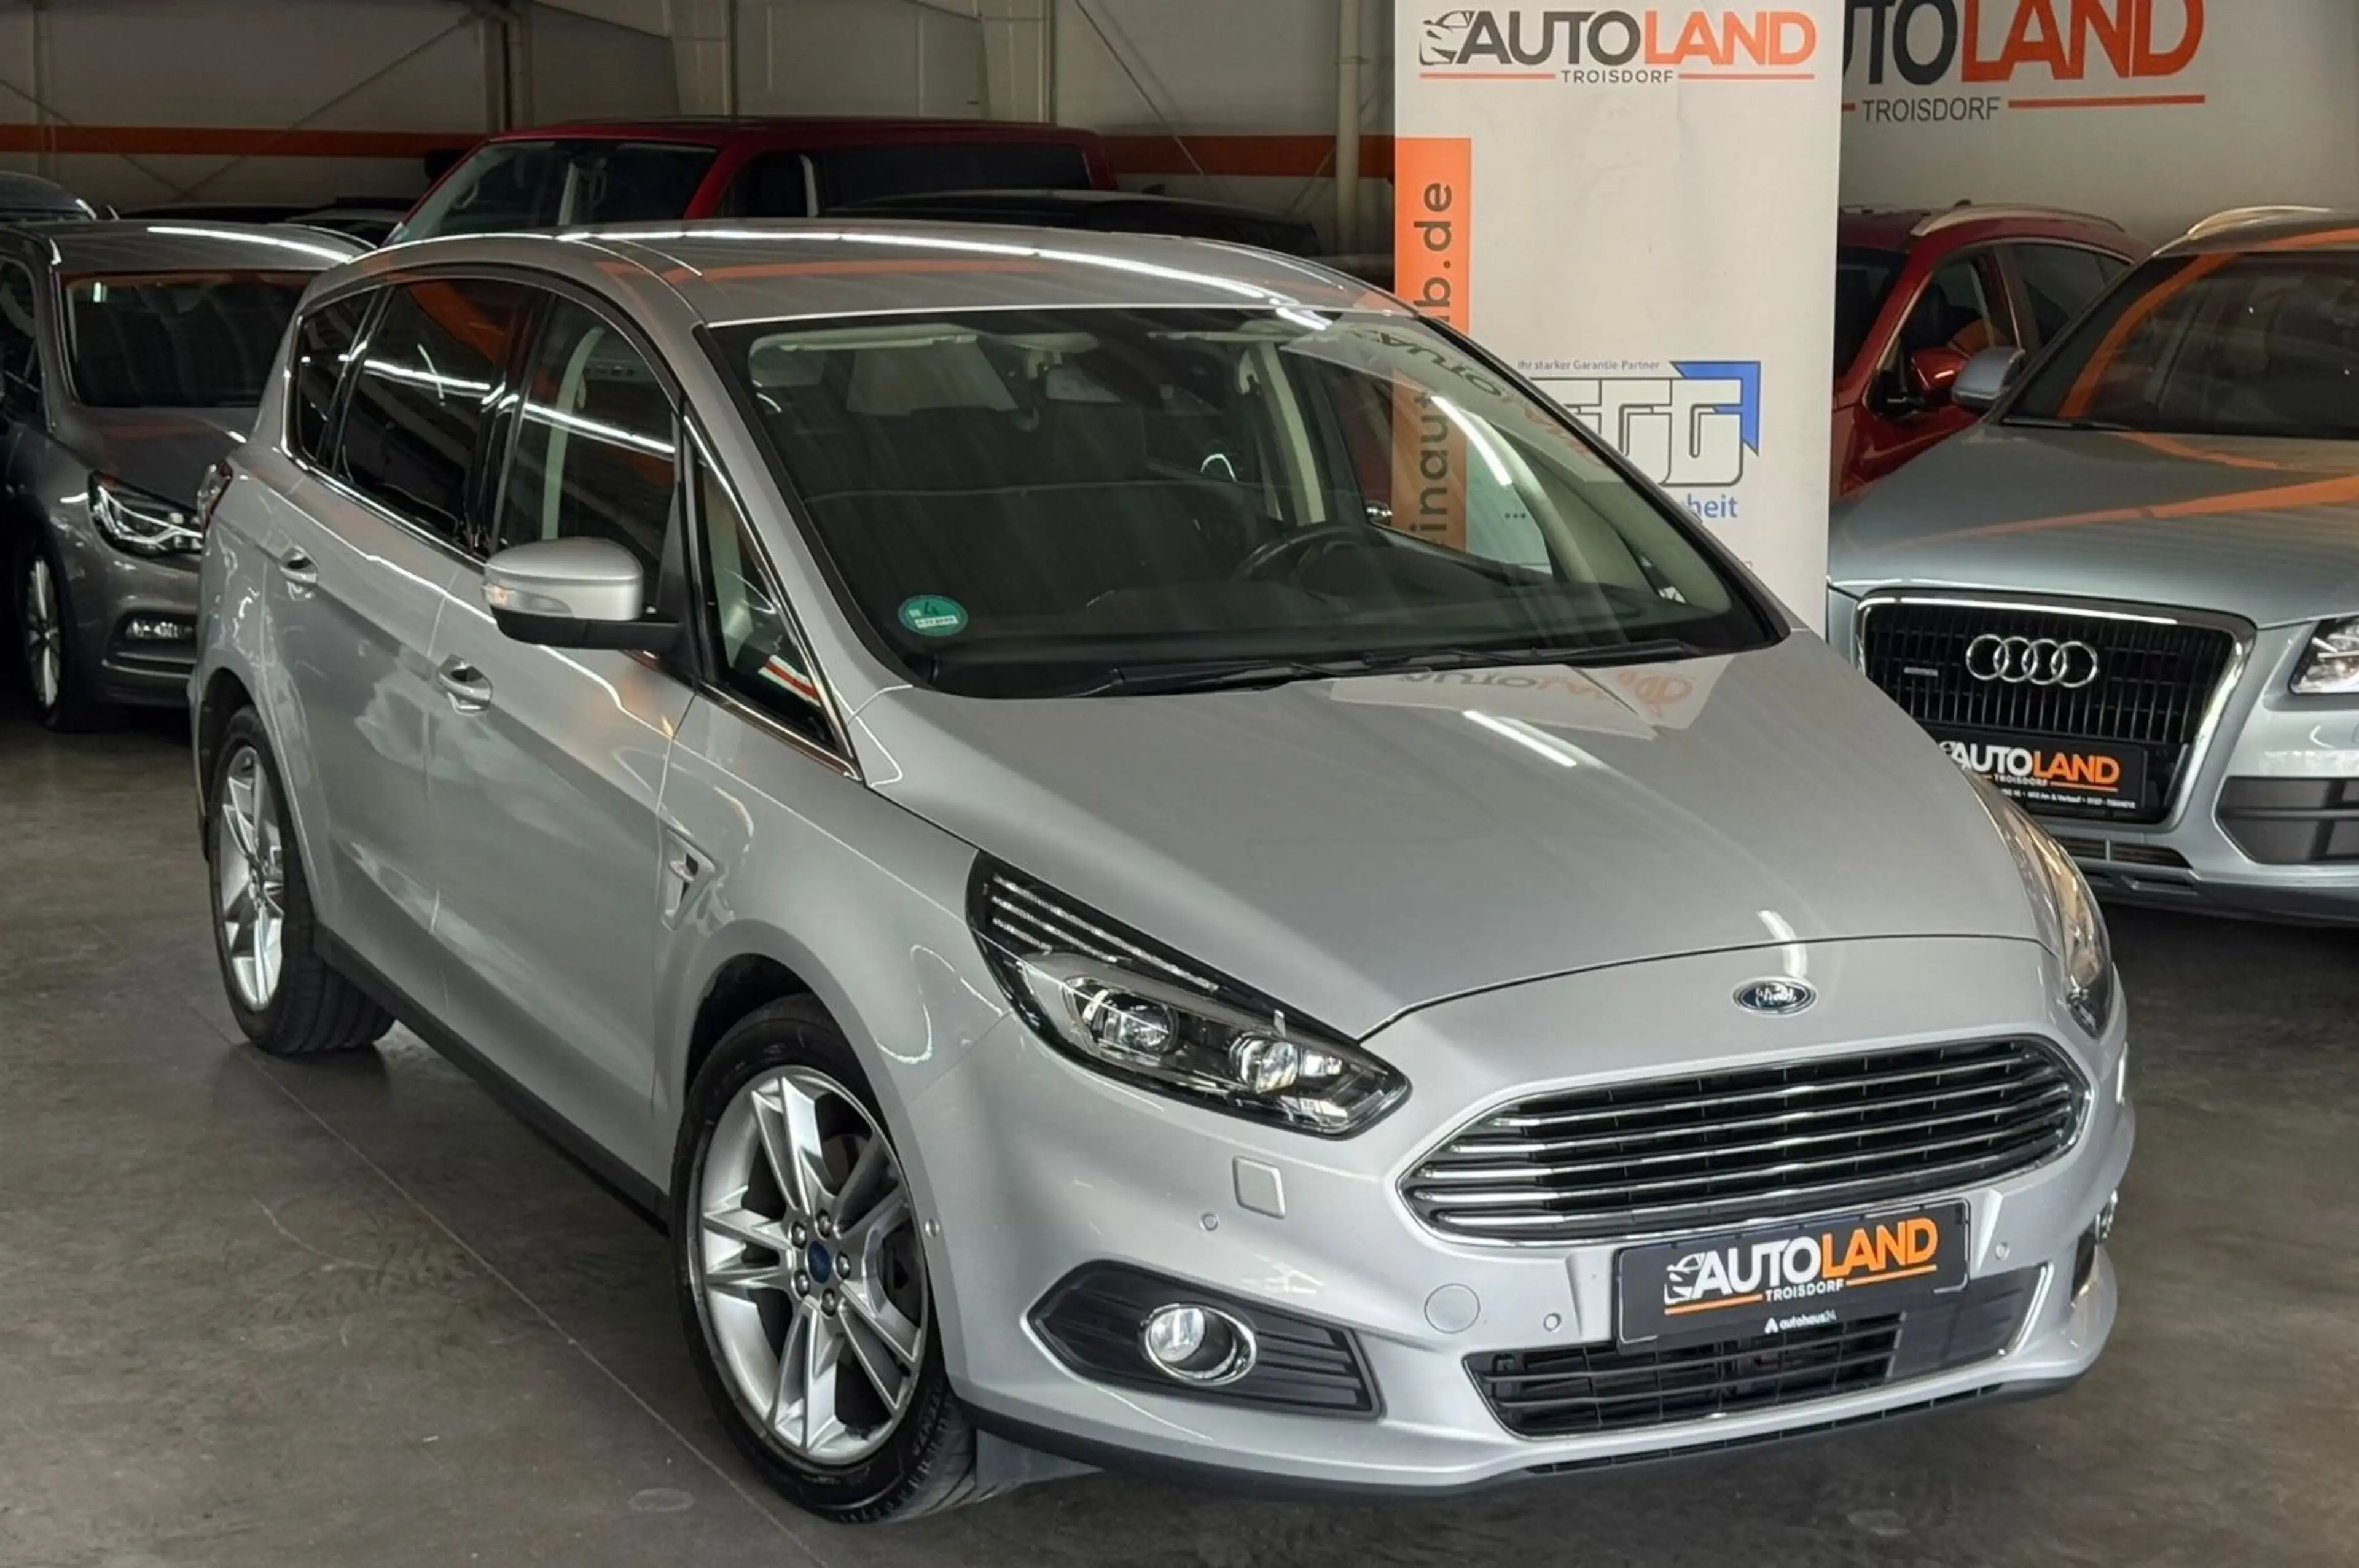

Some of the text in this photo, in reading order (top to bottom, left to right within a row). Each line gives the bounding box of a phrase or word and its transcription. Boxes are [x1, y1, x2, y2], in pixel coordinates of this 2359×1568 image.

[1455, 10, 1816, 66] AUTOLAND
[1561, 70, 1674, 84] TROISDORF
[1862, 97, 2001, 122] TROISDORF
[1413, 182, 1452, 323] b.de
[1409, 391, 1450, 542] inaut
[1683, 493, 1738, 518] heit
[1690, 1217, 1938, 1300] AUTOLAND
[1764, 1279, 1844, 1303] TROISDORF
